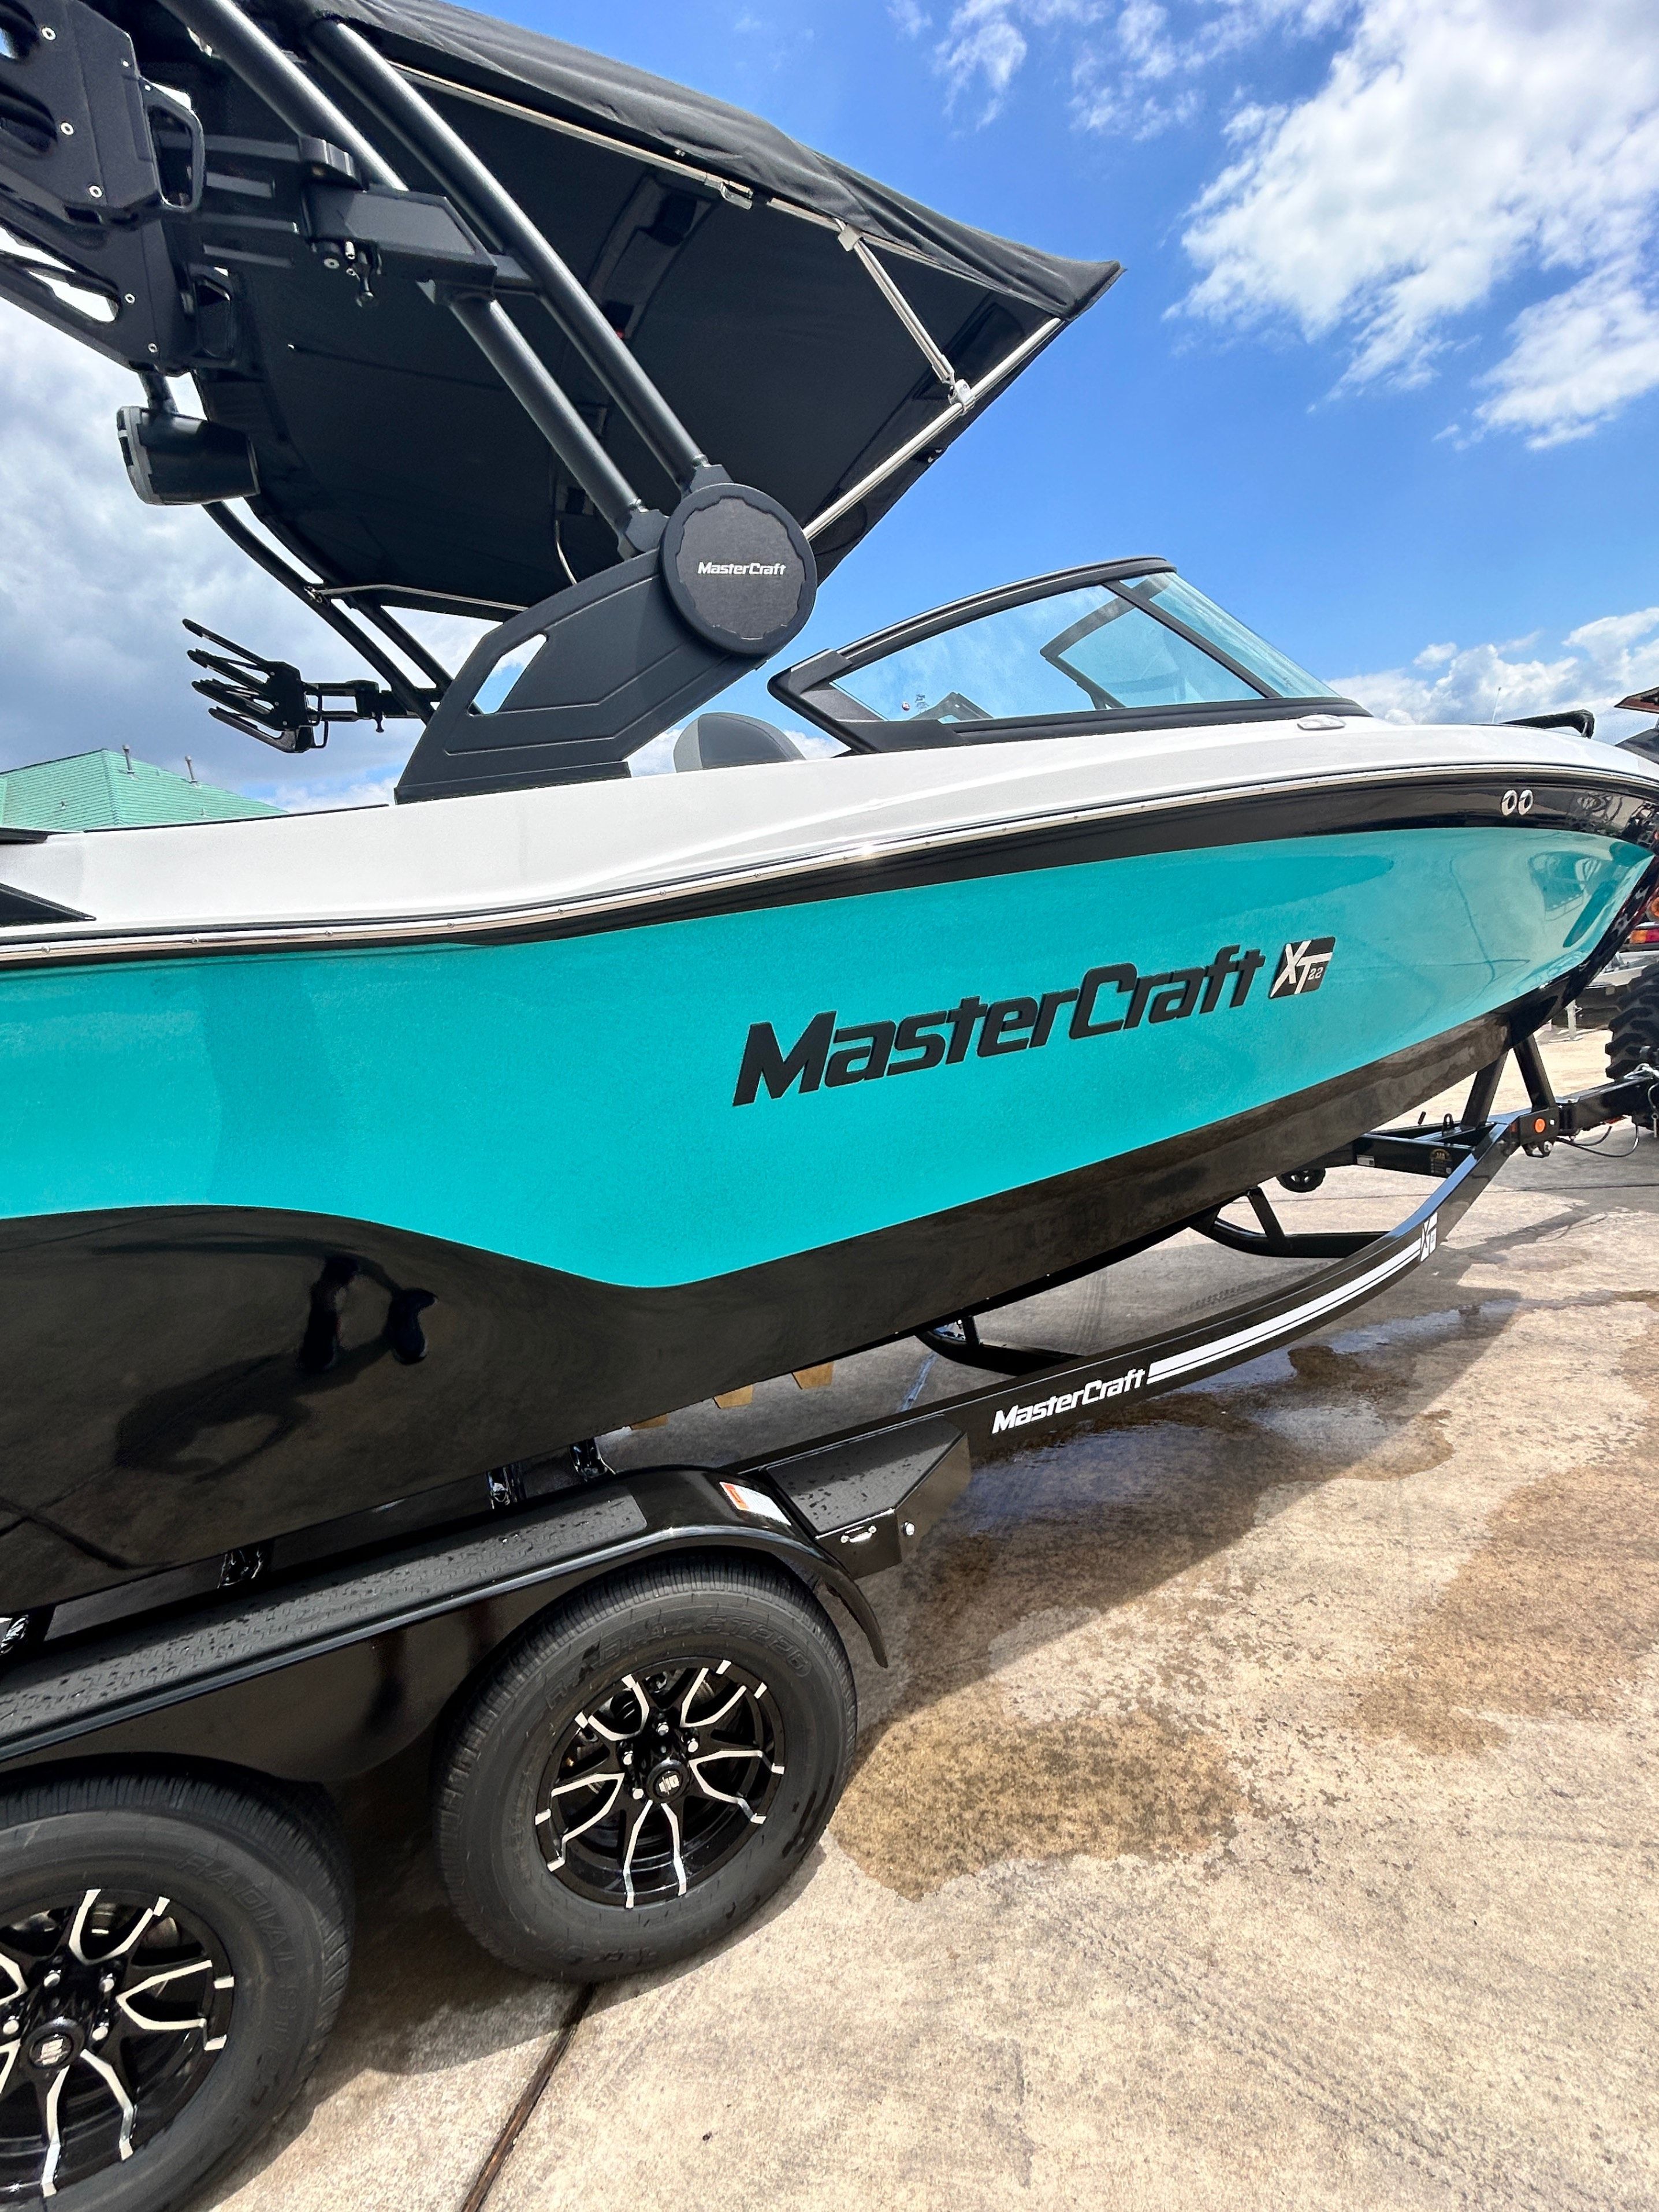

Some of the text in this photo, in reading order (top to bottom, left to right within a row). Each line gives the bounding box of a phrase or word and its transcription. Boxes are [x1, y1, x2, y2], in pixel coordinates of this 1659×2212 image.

[697, 562, 786, 575] MasterCraft
[732, 940, 1333, 1107] MasterCraft XT 22
[992, 1368, 1145, 1434] MasterCraft
[174, 1852, 296, 1974] RADIAL
